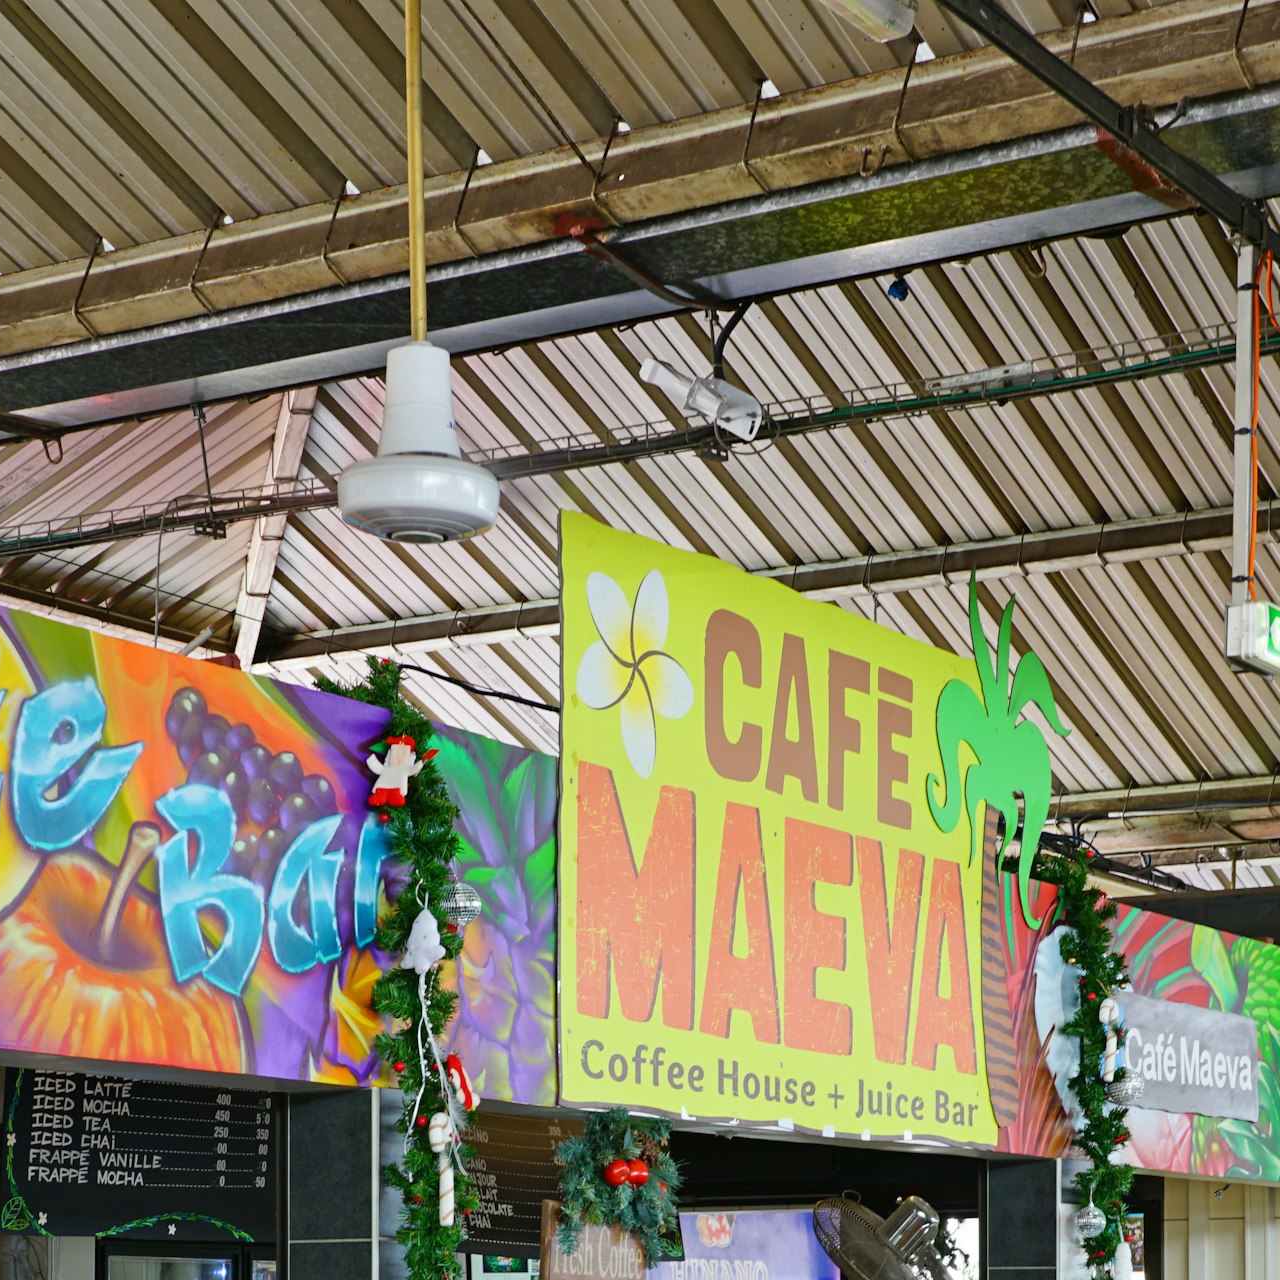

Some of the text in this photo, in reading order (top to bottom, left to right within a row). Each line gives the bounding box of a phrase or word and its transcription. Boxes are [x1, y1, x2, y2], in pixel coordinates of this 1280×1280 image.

[156, 785, 391, 997] Bar
[576, 760, 978, 1076] MAEVA
[1125, 1027, 1253, 1092] Café Maeva
[33, 1077, 76, 1093] ICED
[217, 1094, 231, 1106] 400
[581, 1039, 979, 1128] Coffee House + Juice Bar
[33, 1095, 230, 1122] ICED MOCHA 450
[31, 1131, 73, 1146] ICED
[32, 1113, 269, 1140] ICED TEA 250 350
[29, 1149, 90, 1166] FRAPPÉ
[28, 1166, 144, 1187] FRAPPÉ MOCHA
[598, 1225, 644, 1280] Coffee
